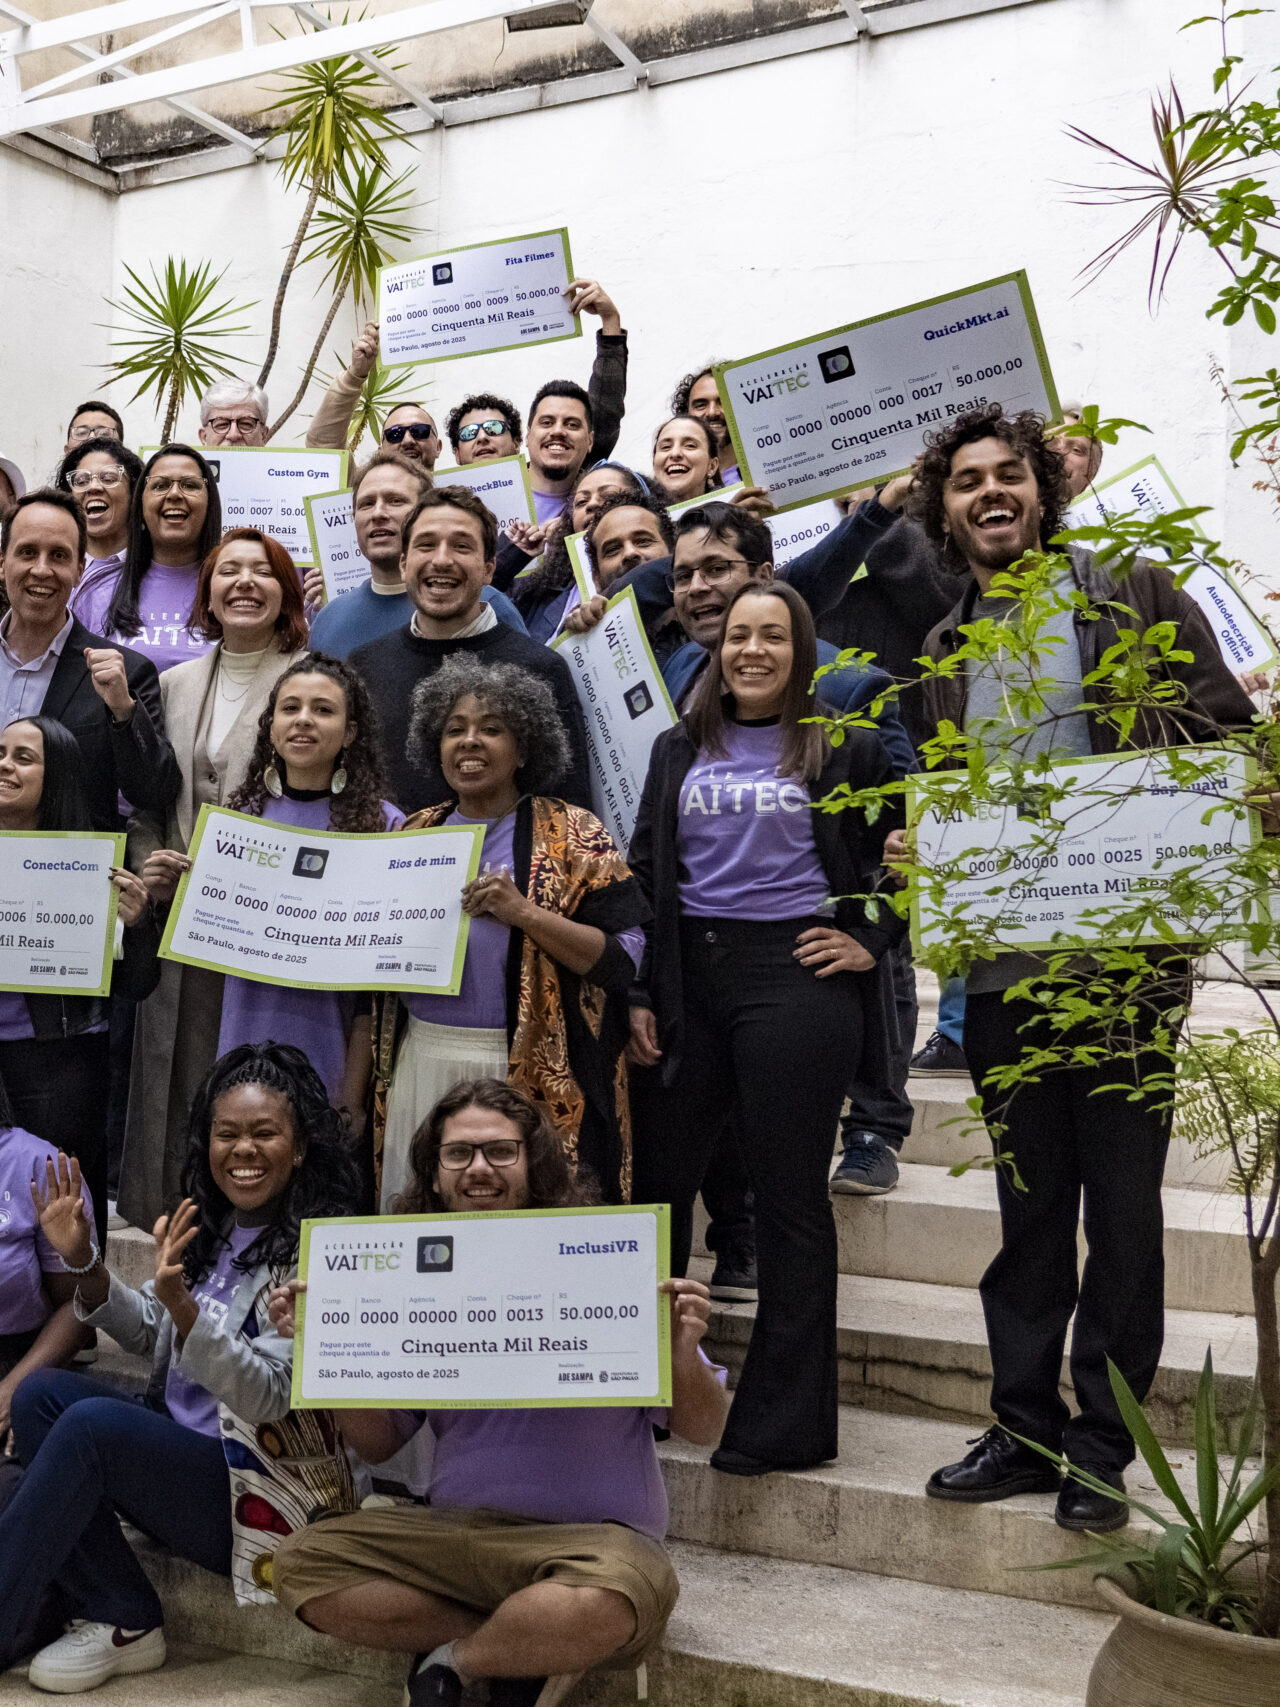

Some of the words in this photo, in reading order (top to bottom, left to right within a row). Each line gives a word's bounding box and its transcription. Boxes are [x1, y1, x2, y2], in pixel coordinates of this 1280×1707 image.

[506, 256, 523, 266] Fita
[525, 251, 554, 262] Filmes
[387, 277, 425, 293] VAITEC
[487, 296, 509, 306] 0009
[516, 286, 560, 301] 50.000,00
[432, 316, 484, 332] Cinquenta
[488, 314, 504, 323] Mil
[507, 308, 535, 320] Reais
[923, 306, 1010, 341] QuickMkt.ai
[743, 371, 812, 405] VAITEC
[757, 433, 782, 448] 000
[789, 420, 823, 439] 0000
[830, 405, 872, 426] 00000
[879, 394, 905, 410] 000
[912, 383, 943, 400] 0017
[956, 358, 1023, 388] 50.000,00
[831, 420, 913, 451] Cinquenta
[916, 408, 942, 428] Mil
[945, 394, 988, 417] Reais
[268, 468, 304, 478] Custom
[307, 469, 329, 480] Gym
[770, 479, 786, 492] São
[788, 471, 816, 487] Paulo,
[819, 463, 850, 479] agosto
[852, 458, 862, 469] de
[864, 449, 887, 465] 2025
[228, 506, 245, 515] 000
[250, 506, 273, 516] 0007
[269, 525, 297, 535] Reais
[774, 522, 830, 550] 50.000,00
[1207, 585, 1254, 658] Audiodescrição
[604, 620, 631, 680] VAITEC
[1221, 630, 1244, 664] Offline
[605, 786, 621, 812] Mil
[619, 777, 634, 807] 0012
[680, 779, 806, 816] AITEC
[216, 840, 281, 869] VAITEC
[388, 858, 412, 870] Rios
[415, 858, 426, 868] de
[430, 855, 456, 866] mim
[1104, 849, 1143, 864] 0025
[23, 860, 99, 872] ConectaCom
[1009, 883, 1100, 901] Cinquenta
[1104, 878, 1131, 894] Mil
[201, 885, 227, 901] 000
[235, 894, 269, 911] 0000
[276, 905, 317, 920] 00000
[324, 910, 346, 922] 000
[353, 911, 379, 922] 0018
[389, 908, 446, 921] 50.000,00
[36, 912, 94, 925] 50.000,00
[18, 936, 54, 948] Reais
[264, 926, 341, 946] Cinquenta
[345, 933, 366, 946] Mil
[370, 933, 403, 945] Reais
[558, 1240, 639, 1255] InclusiVR
[325, 1252, 402, 1272] VAITEC
[322, 1311, 350, 1325] 000
[360, 1310, 399, 1324] 0000
[408, 1310, 457, 1324] 00000
[467, 1309, 496, 1323] 000
[506, 1308, 544, 1322] 0013
[559, 1305, 639, 1321] 50.000,00
[319, 1350, 341, 1358] cheque
[352, 1350, 378, 1358] quantia
[320, 1342, 341, 1350] Pague
[343, 1342, 357, 1350] por
[401, 1338, 498, 1356] Cinquenta
[503, 1338, 533, 1353] Mil
[538, 1336, 588, 1351] Reais
[318, 1368, 338, 1380] São
[341, 1368, 373, 1380] Paulo,
[377, 1368, 416, 1381] agosto
[417, 1368, 430, 1379] de
[432, 1368, 459, 1378] 2025
